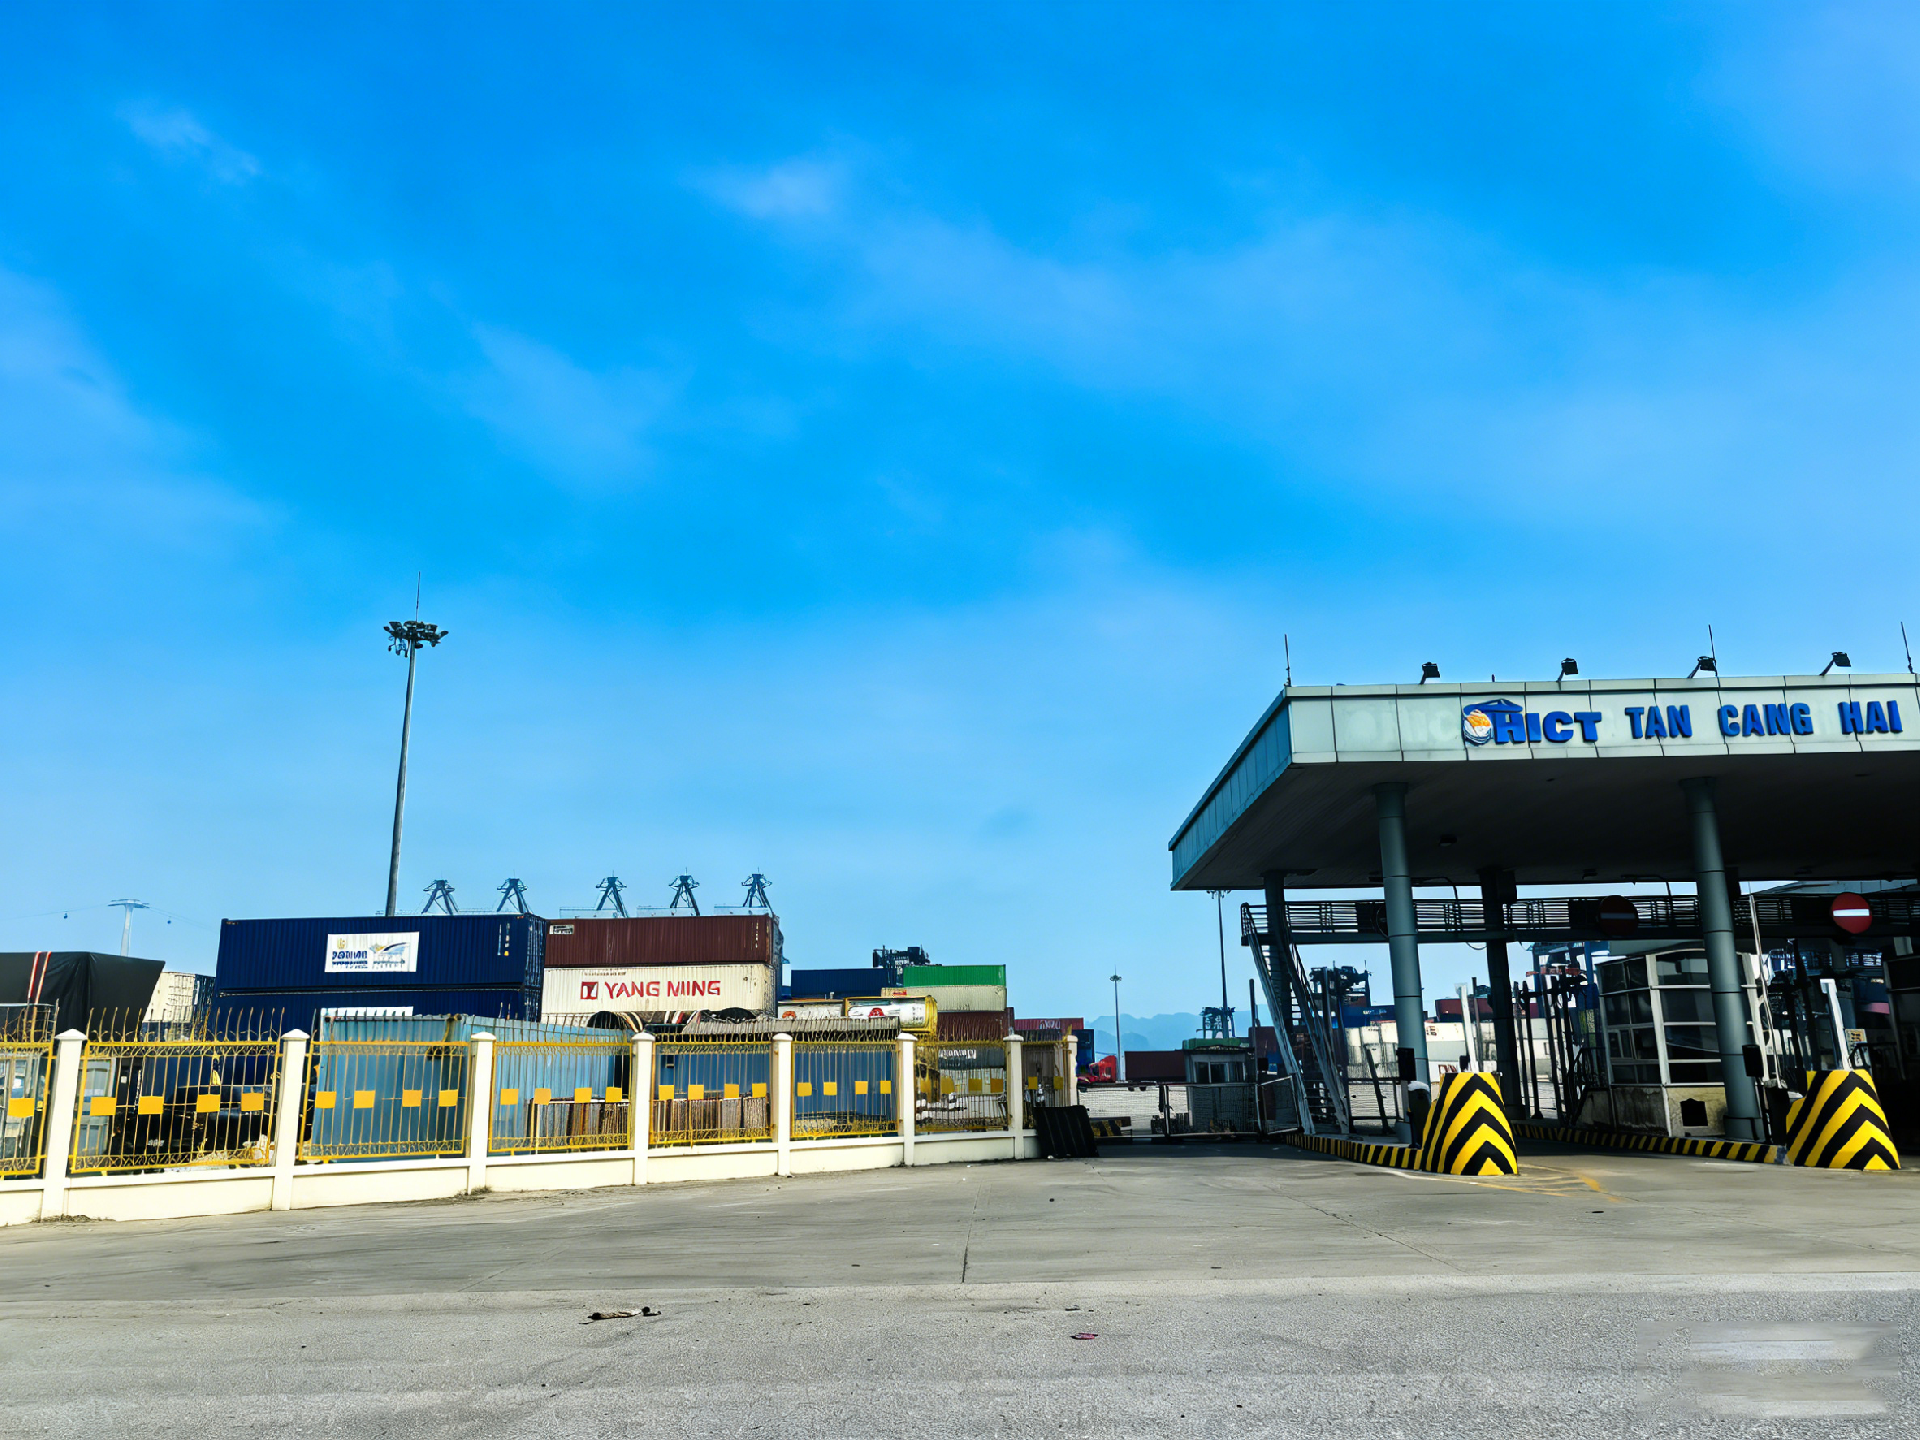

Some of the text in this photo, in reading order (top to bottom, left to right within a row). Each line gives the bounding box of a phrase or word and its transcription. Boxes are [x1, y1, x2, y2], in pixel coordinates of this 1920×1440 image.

[1493, 700, 1903, 744] HICT TAN CANG HAI
[604, 980, 721, 999] YANG MING
